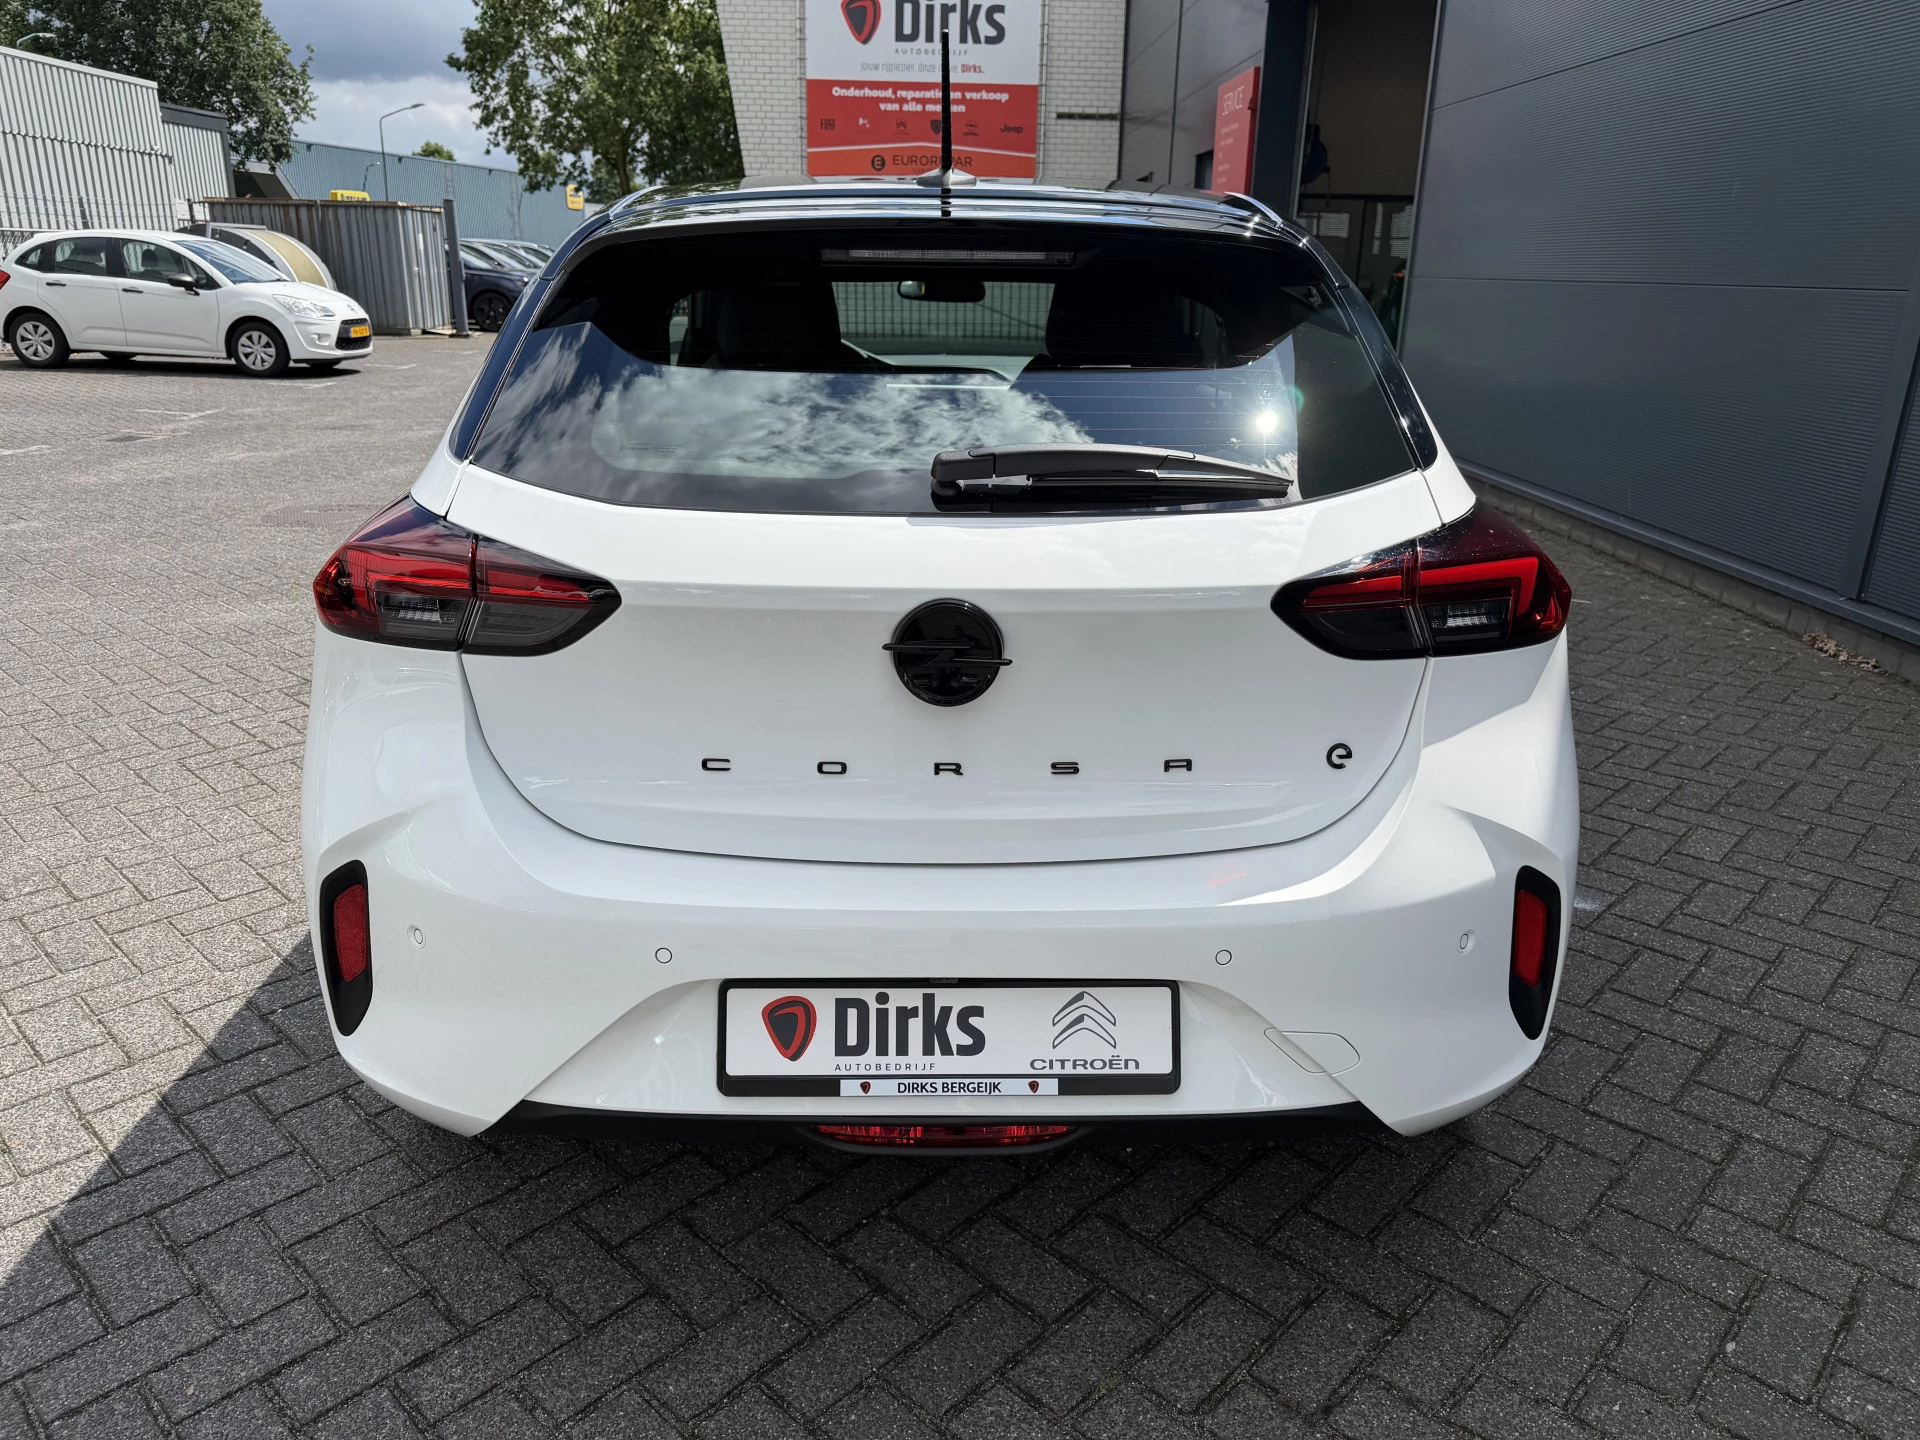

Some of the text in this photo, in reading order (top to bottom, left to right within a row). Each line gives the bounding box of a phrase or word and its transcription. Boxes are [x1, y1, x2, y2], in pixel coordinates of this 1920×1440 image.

[895, 0, 1006, 45] Dirks
[894, 48, 968, 56] AUTOBEDIJF
[831, 86, 896, 99] Onderhoud,
[965, 90, 1009, 103] verkoop
[879, 102, 900, 111] van
[902, 101, 923, 112] alle
[1000, 124, 1023, 134] Jeep
[892, 154, 973, 168] EURORAR
[1326, 742, 1352, 770] e
[701, 757, 1193, 776] CORSA
[834, 991, 986, 1057] Dirks
[834, 1062, 936, 1072] AUTOBEDRIJF
[897, 1081, 1002, 1095] DIRKS BERGEIJK
